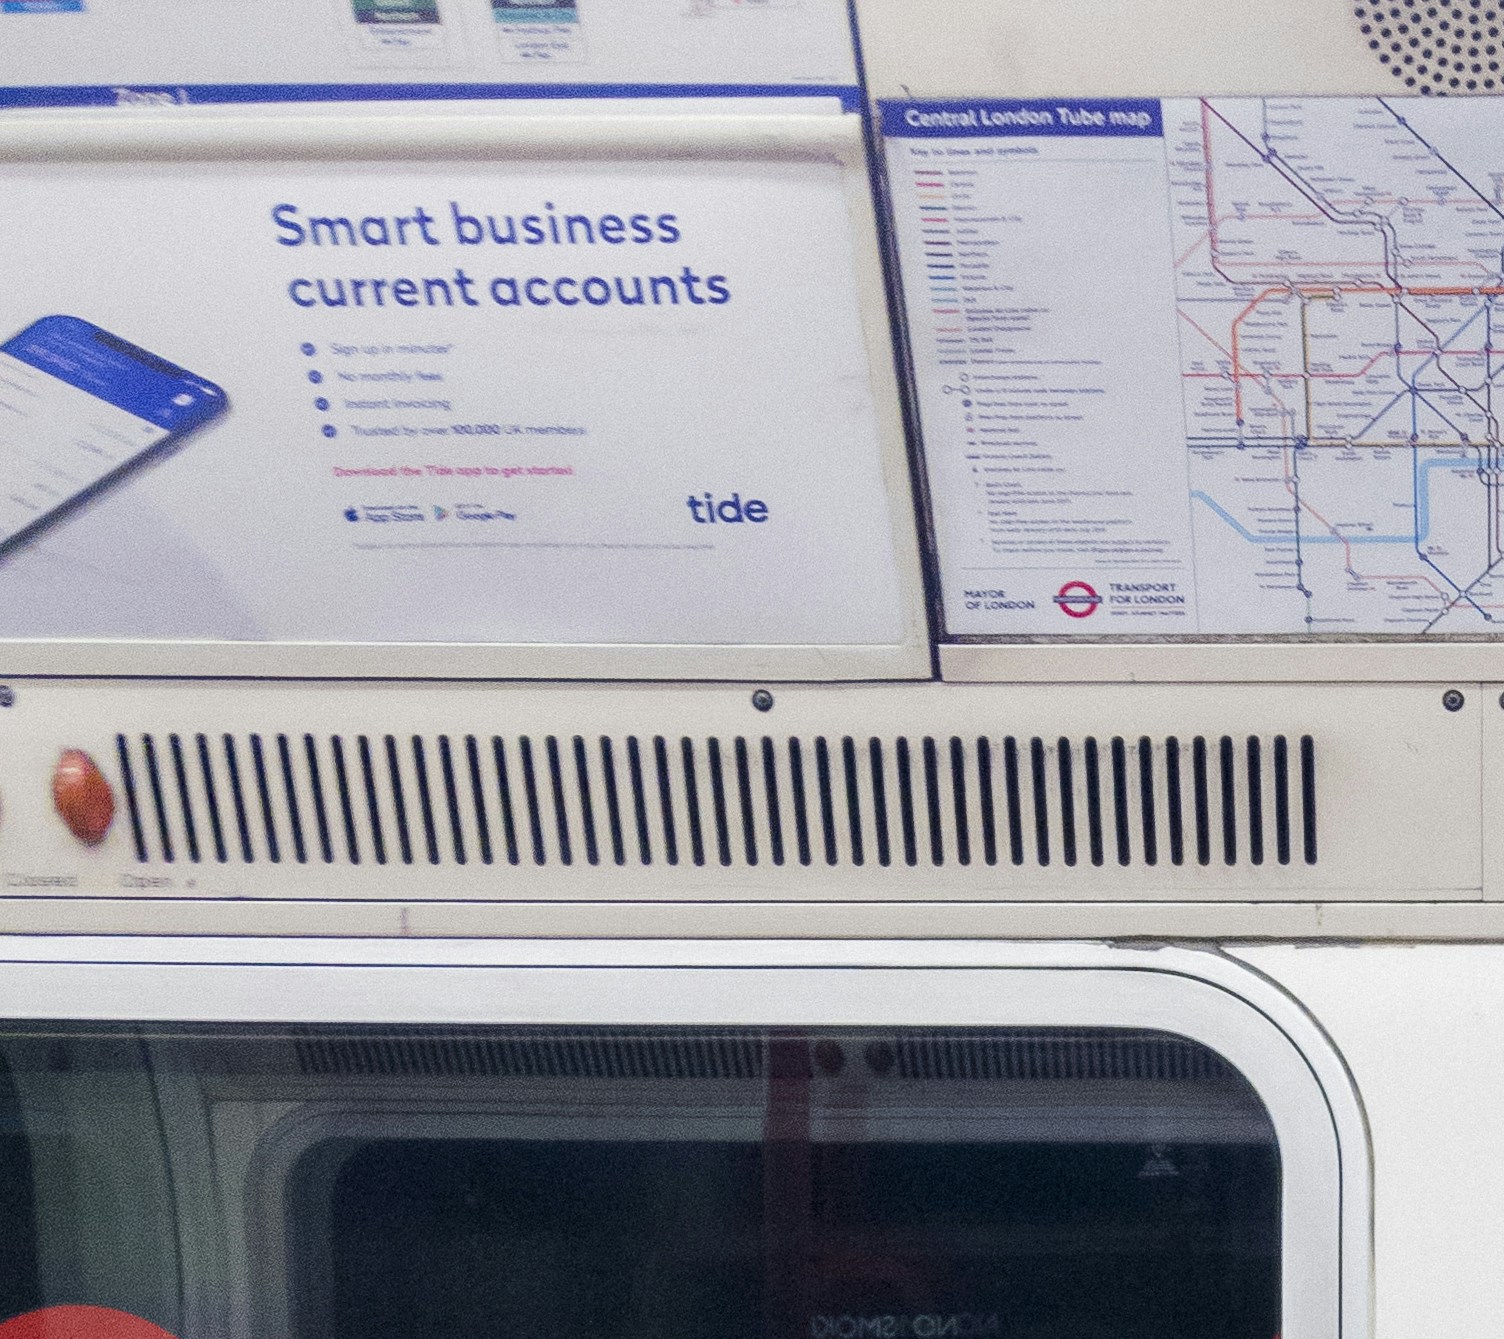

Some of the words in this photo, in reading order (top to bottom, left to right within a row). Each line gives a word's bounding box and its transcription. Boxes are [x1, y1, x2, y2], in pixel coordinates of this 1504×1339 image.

[904, 108, 978, 128] Central
[979, 107, 1054, 126] London
[1057, 107, 1105, 125] Tube
[1109, 110, 1152, 129] map
[271, 202, 441, 246] Smart
[448, 201, 682, 245] business
[287, 268, 480, 307] current
[488, 266, 732, 305] accounts
[686, 490, 770, 524] tide
[1109, 582, 1177, 593] TRANSPORT
[985, 600, 1036, 611] LONDON
[1110, 594, 1132, 605] FOR
[1133, 594, 1186, 605] LONDON
